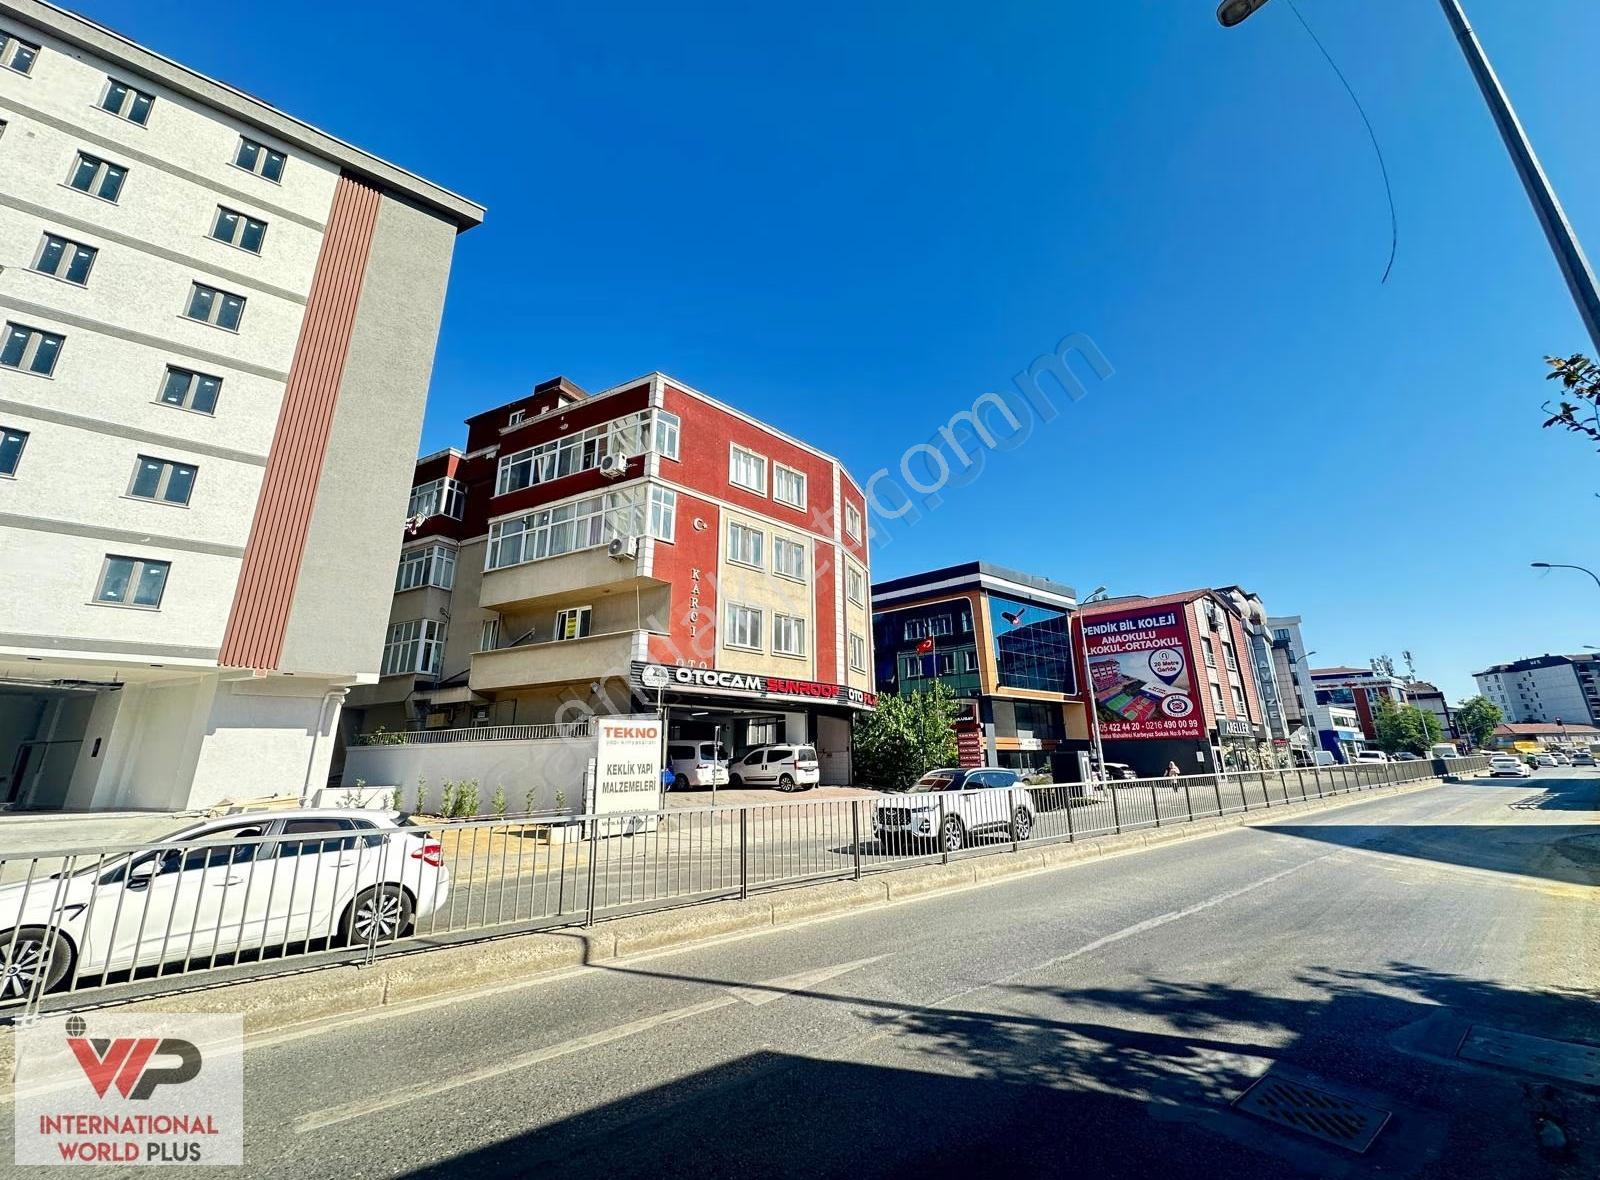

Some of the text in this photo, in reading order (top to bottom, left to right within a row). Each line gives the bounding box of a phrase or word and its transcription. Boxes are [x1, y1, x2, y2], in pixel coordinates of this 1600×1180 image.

[1083, 612, 1175, 636] PENDİK BİL KOLEJİ
[1101, 630, 1156, 645] ANAOKULU
[675, 667, 839, 697] OTOCAM SUNROOF
[848, 688, 863, 702] OTO
[603, 726, 658, 739] TEKNO
[1109, 723, 1121, 731] 422
[1122, 722, 1131, 730] 44
[1131, 722, 1140, 730] 20
[1145, 721, 1163, 730] 0216
[1163, 720, 1177, 729] 490
[1177, 720, 1188, 728] 00
[1188, 719, 1198, 728] 99
[606, 761, 653, 776] KEKLİK YAPI
[602, 777, 657, 794] MALZEMELERİ
